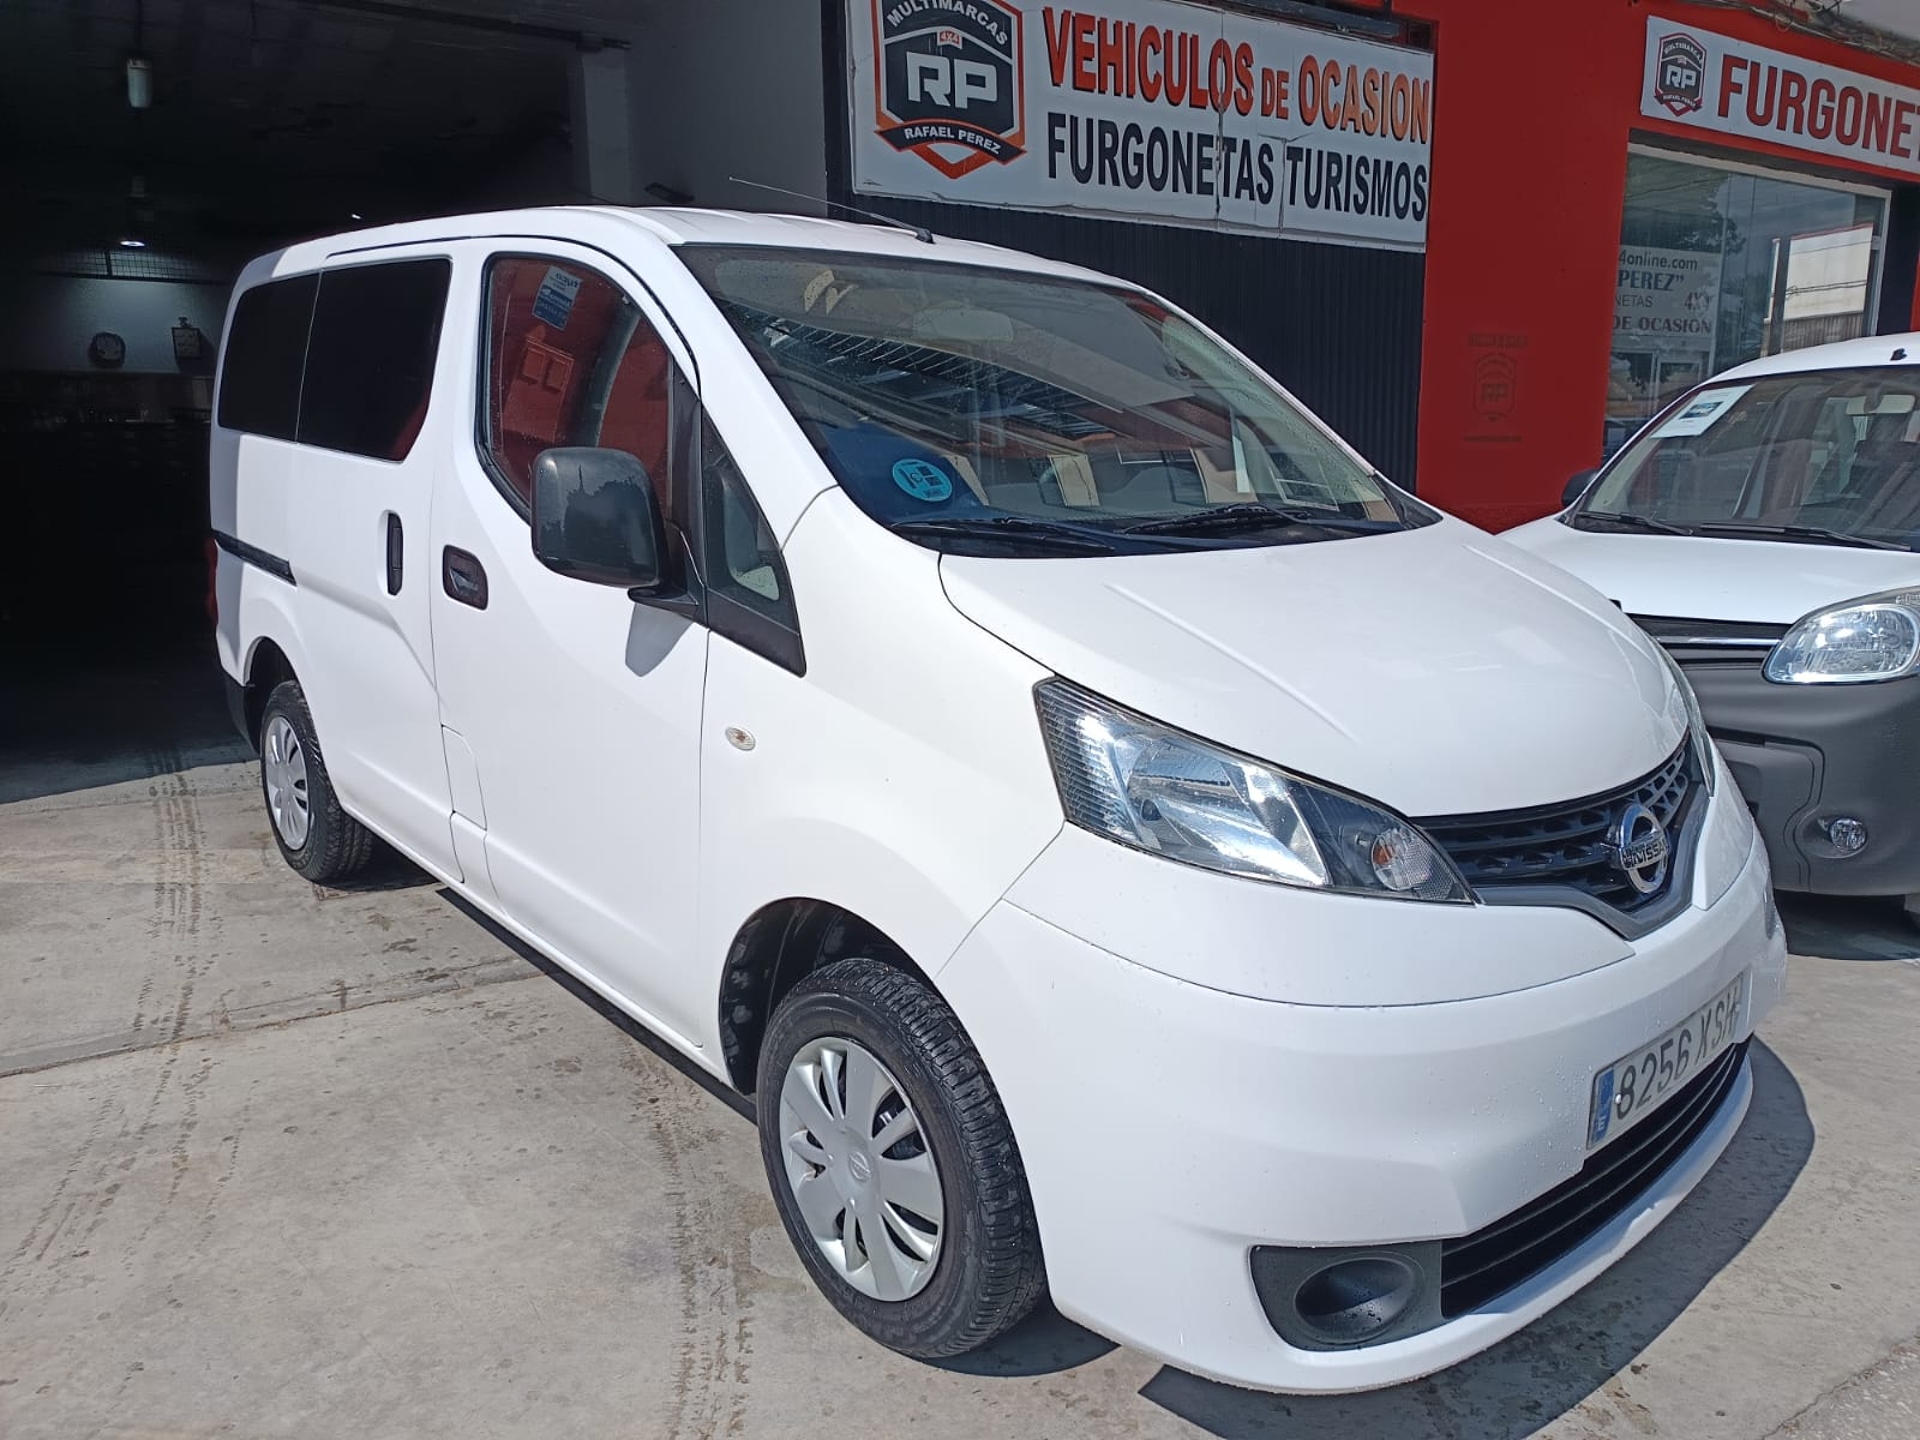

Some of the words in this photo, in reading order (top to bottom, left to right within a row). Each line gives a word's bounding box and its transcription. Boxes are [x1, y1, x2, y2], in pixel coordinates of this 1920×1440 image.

[886, 0, 1008, 45] MULTIMARCAS
[906, 51, 998, 109] RP
[1042, 6, 1255, 115] VEHICULOS
[1261, 66, 1290, 119] DE
[1299, 54, 1431, 144] OCASION
[1665, 64, 1697, 88] RP
[904, 126, 955, 140] RAFAEL
[957, 129, 1002, 155] PEREZ
[1047, 111, 1275, 204] FURGONETAS
[1286, 146, 1428, 222] TURISMOS
[1616, 1028, 1692, 1120] 8256
